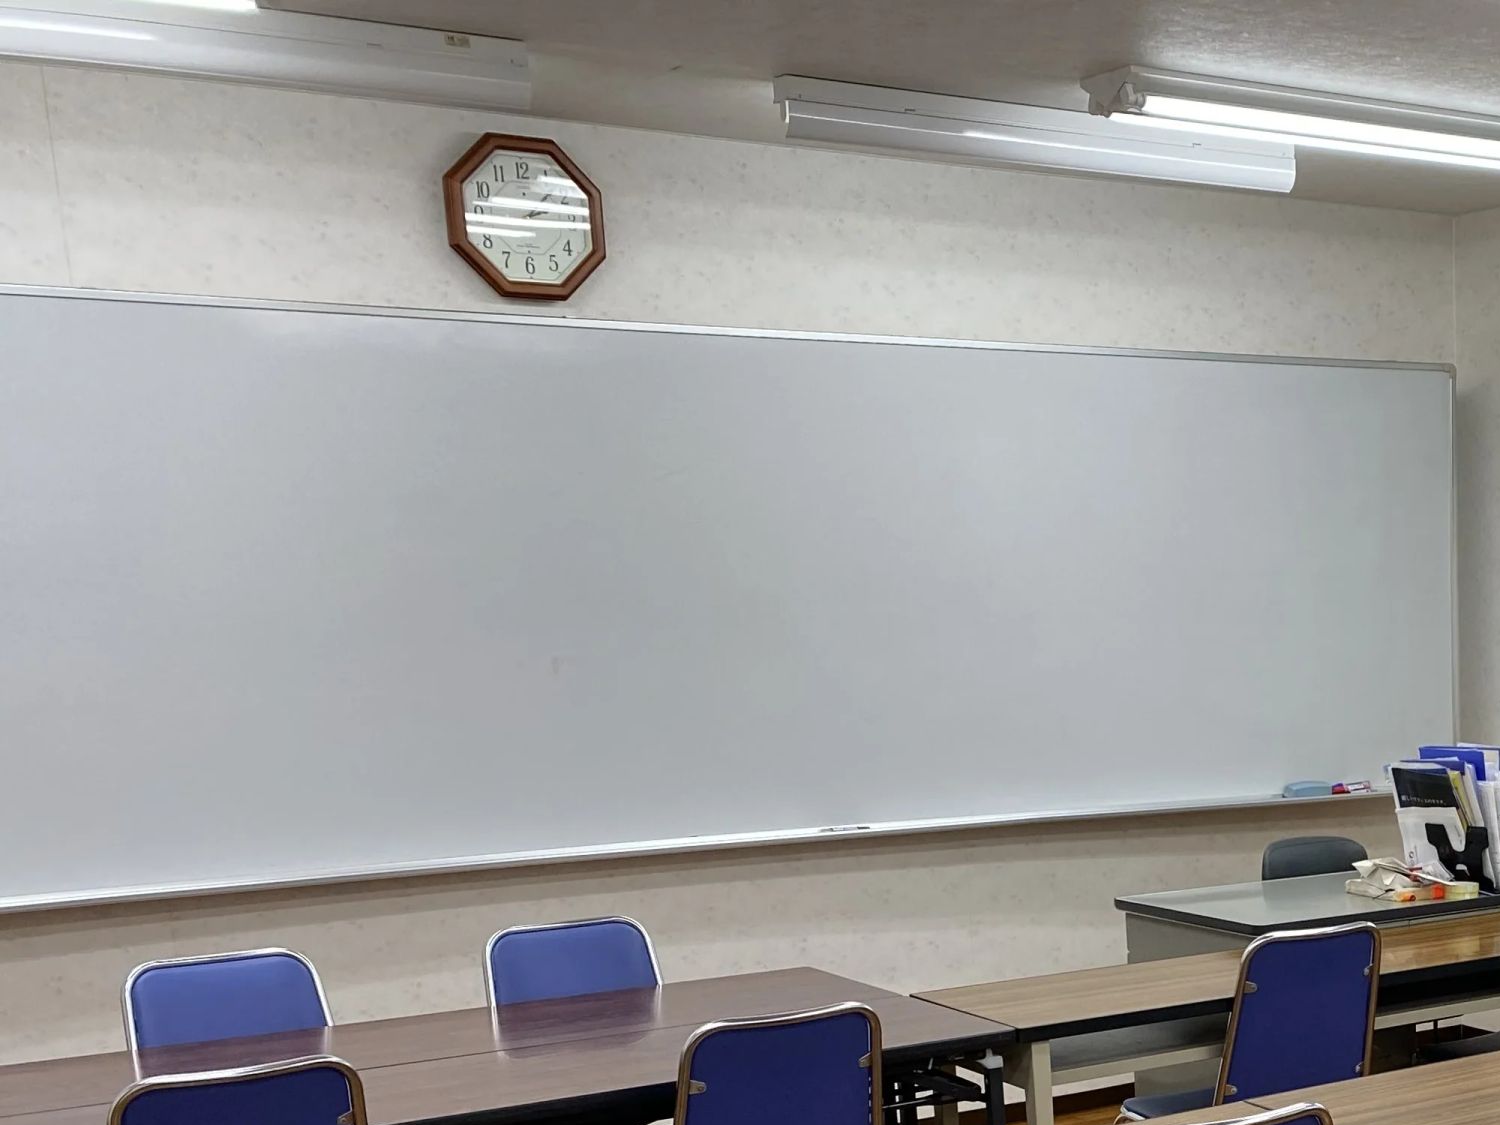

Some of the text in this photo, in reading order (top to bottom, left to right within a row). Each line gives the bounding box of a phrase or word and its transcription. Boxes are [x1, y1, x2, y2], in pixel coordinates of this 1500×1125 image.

[493, 164, 505, 183] 11
[515, 162, 530, 180] 12
[476, 181, 490, 199] 10
[482, 233, 493, 249] 8
[563, 239, 573, 257] 4
[502, 250, 511, 268] 7
[525, 256, 536, 274] 6
[549, 254, 559, 272] 5
